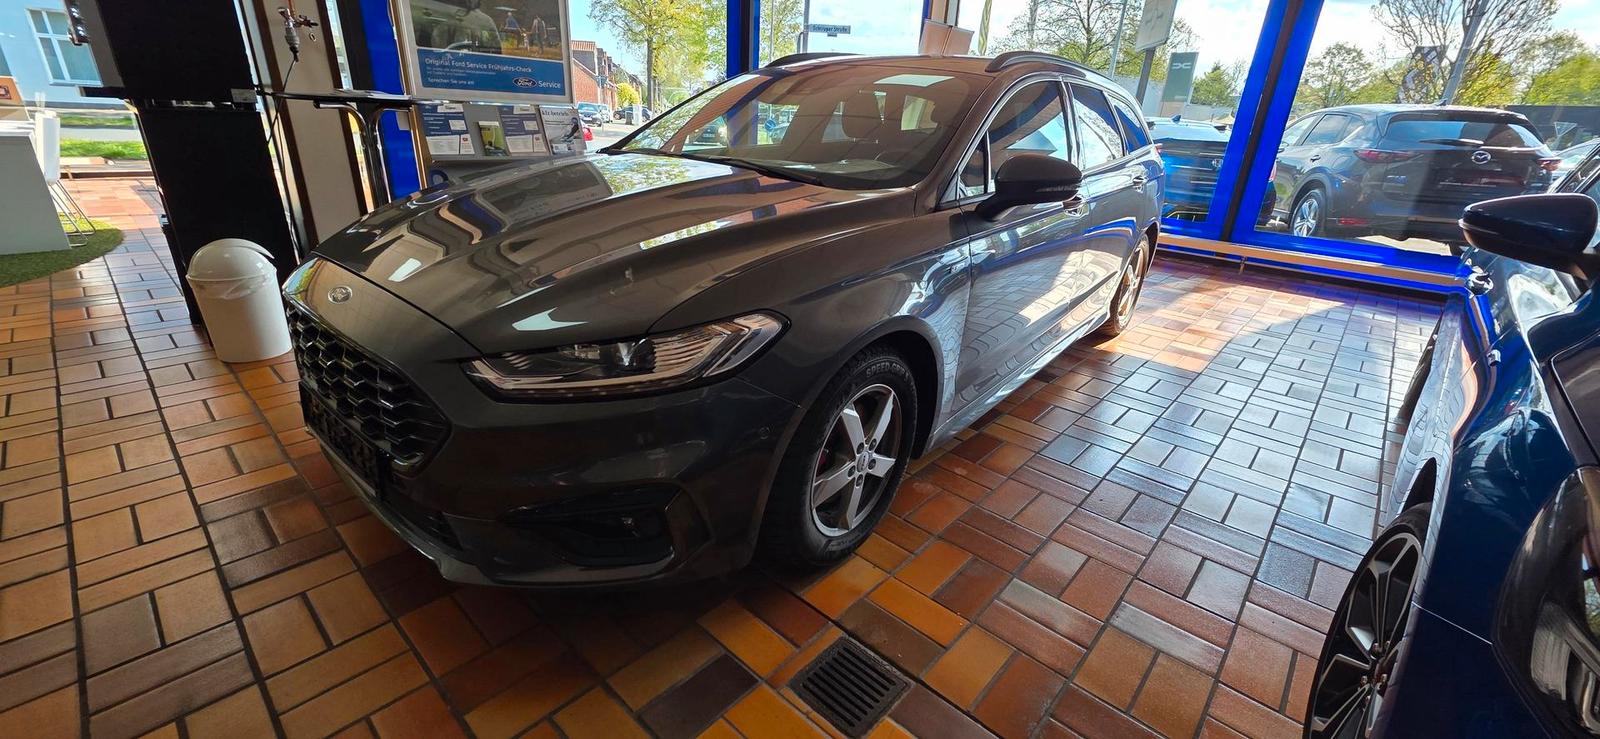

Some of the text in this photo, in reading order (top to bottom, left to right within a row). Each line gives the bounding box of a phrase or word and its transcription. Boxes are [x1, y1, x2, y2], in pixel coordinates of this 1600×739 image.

[425, 58, 450, 66] Original
[466, 61, 487, 69] Service
[488, 63, 532, 73] Frühjahrs-Check
[516, 77, 535, 88] Ford
[538, 81, 561, 89] Service
